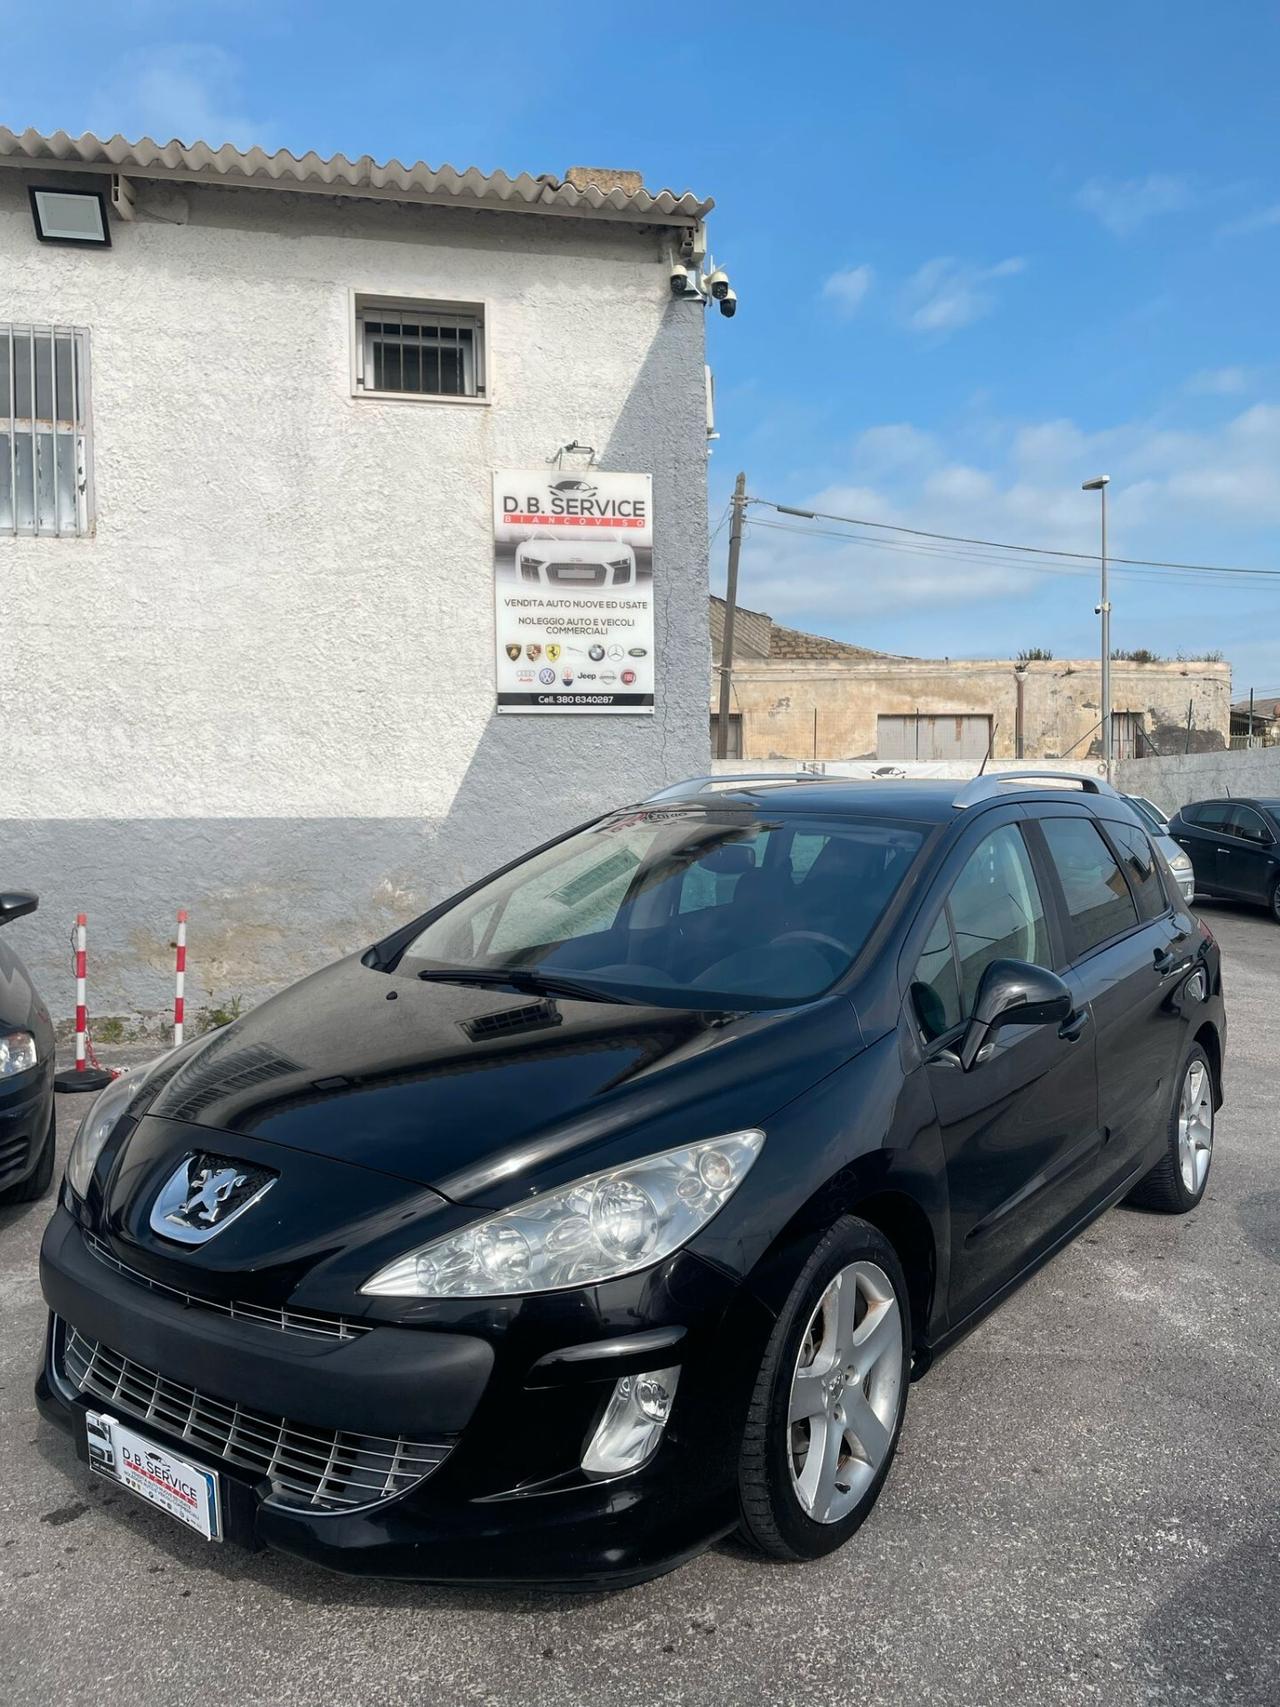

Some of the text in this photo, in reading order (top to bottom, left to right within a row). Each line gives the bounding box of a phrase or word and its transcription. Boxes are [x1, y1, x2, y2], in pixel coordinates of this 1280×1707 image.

[503, 496, 645, 517] D.B. SERVICE
[505, 516, 644, 527] BIANCOVISO
[504, 599, 648, 609] VENDITA AUTO NUOVE ED USATE
[518, 617, 635, 627] NOLEGGIO AUTO E VEICOLI
[545, 626, 608, 635] COMMERCIALI
[577, 672, 597, 681] Jeep
[538, 695, 614, 704] Cell. 380 6340287
[122, 1447, 145, 1470] D.B.
[146, 1459, 198, 1500] SERVICE
